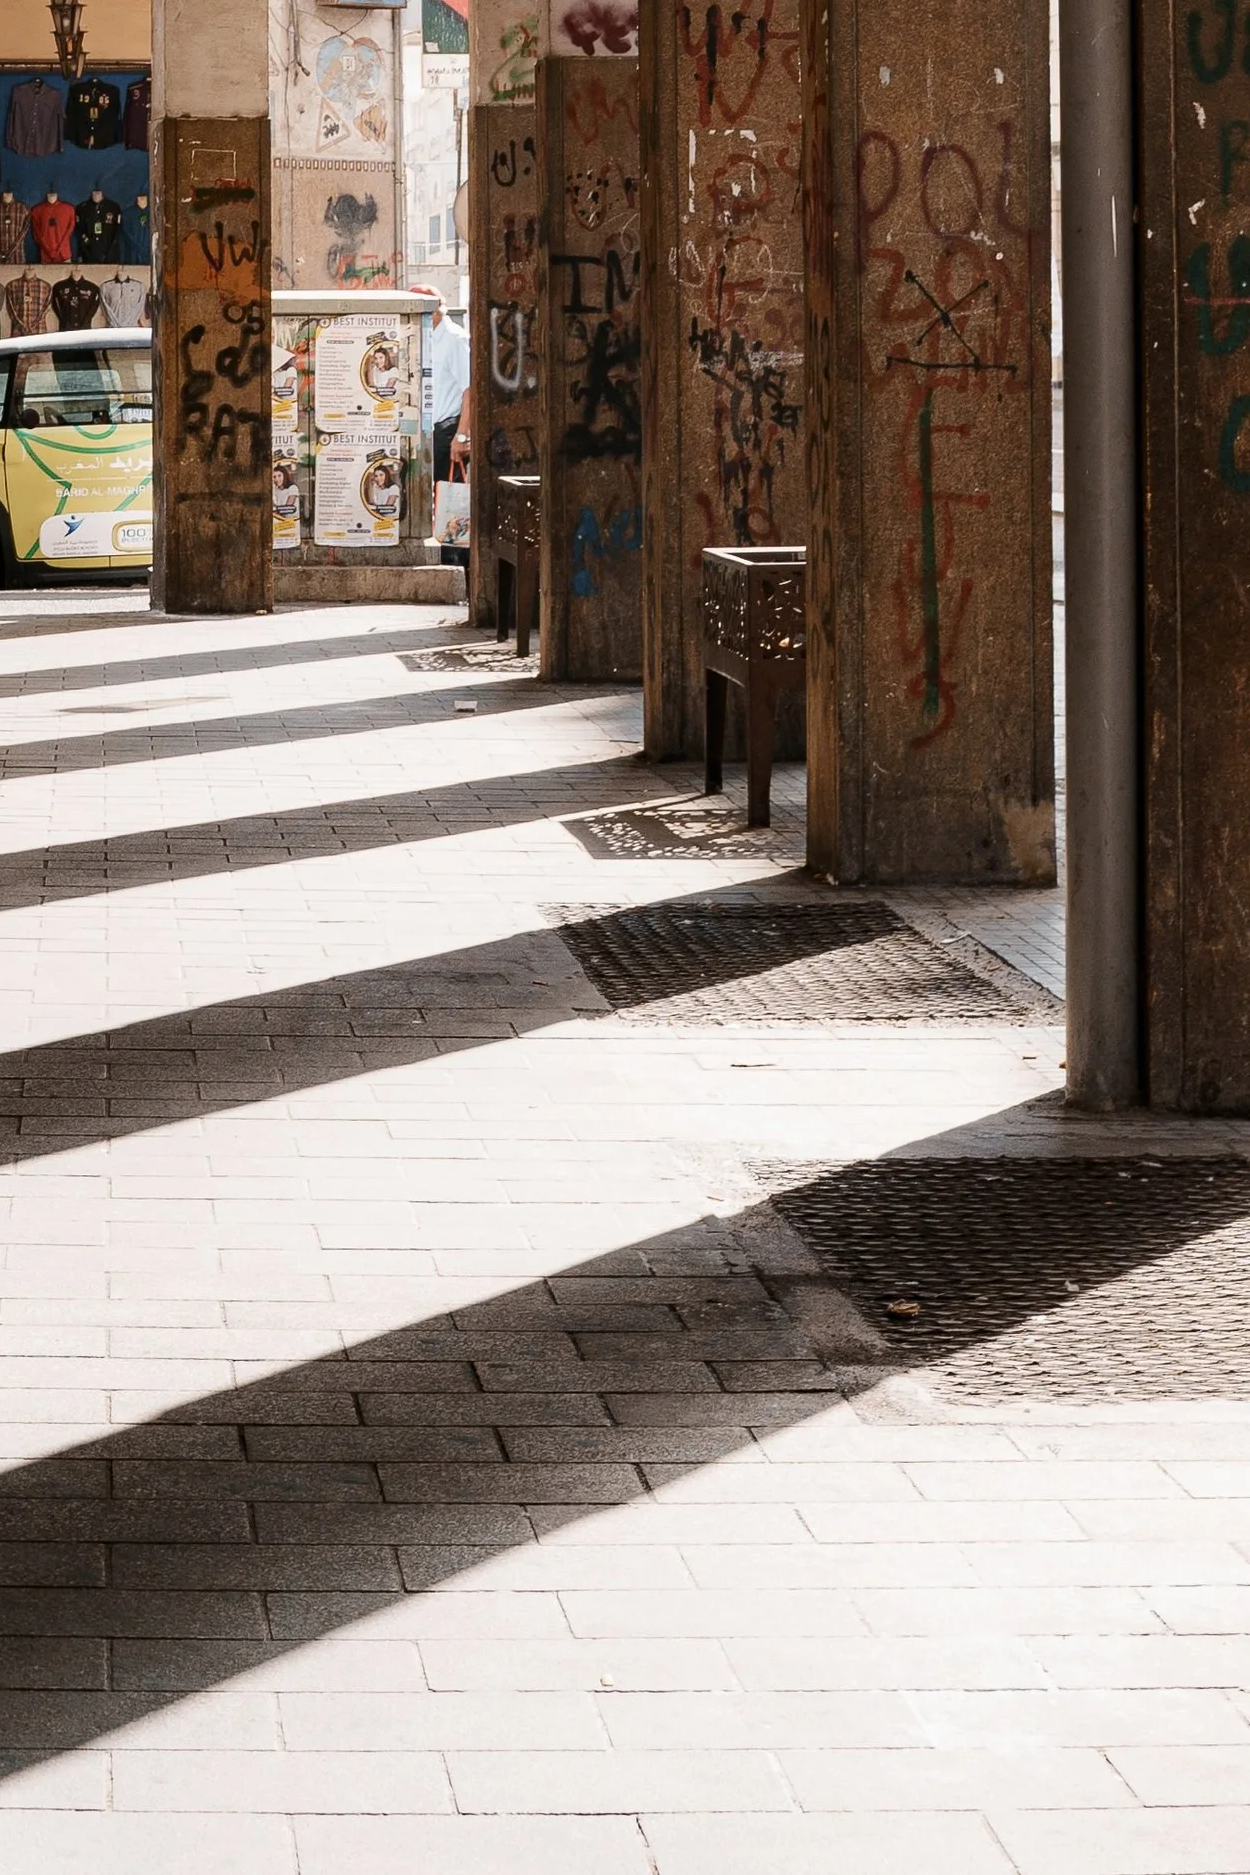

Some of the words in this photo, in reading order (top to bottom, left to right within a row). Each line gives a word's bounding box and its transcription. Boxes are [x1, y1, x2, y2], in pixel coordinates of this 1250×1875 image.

[333, 316, 355, 327] BEST
[358, 316, 397, 327] INSTITUT
[333, 434, 355, 444] BEST
[358, 434, 397, 444] INSTITUT
[56, 456, 103, 475] المغرب
[56, 487, 88, 498] BARID
